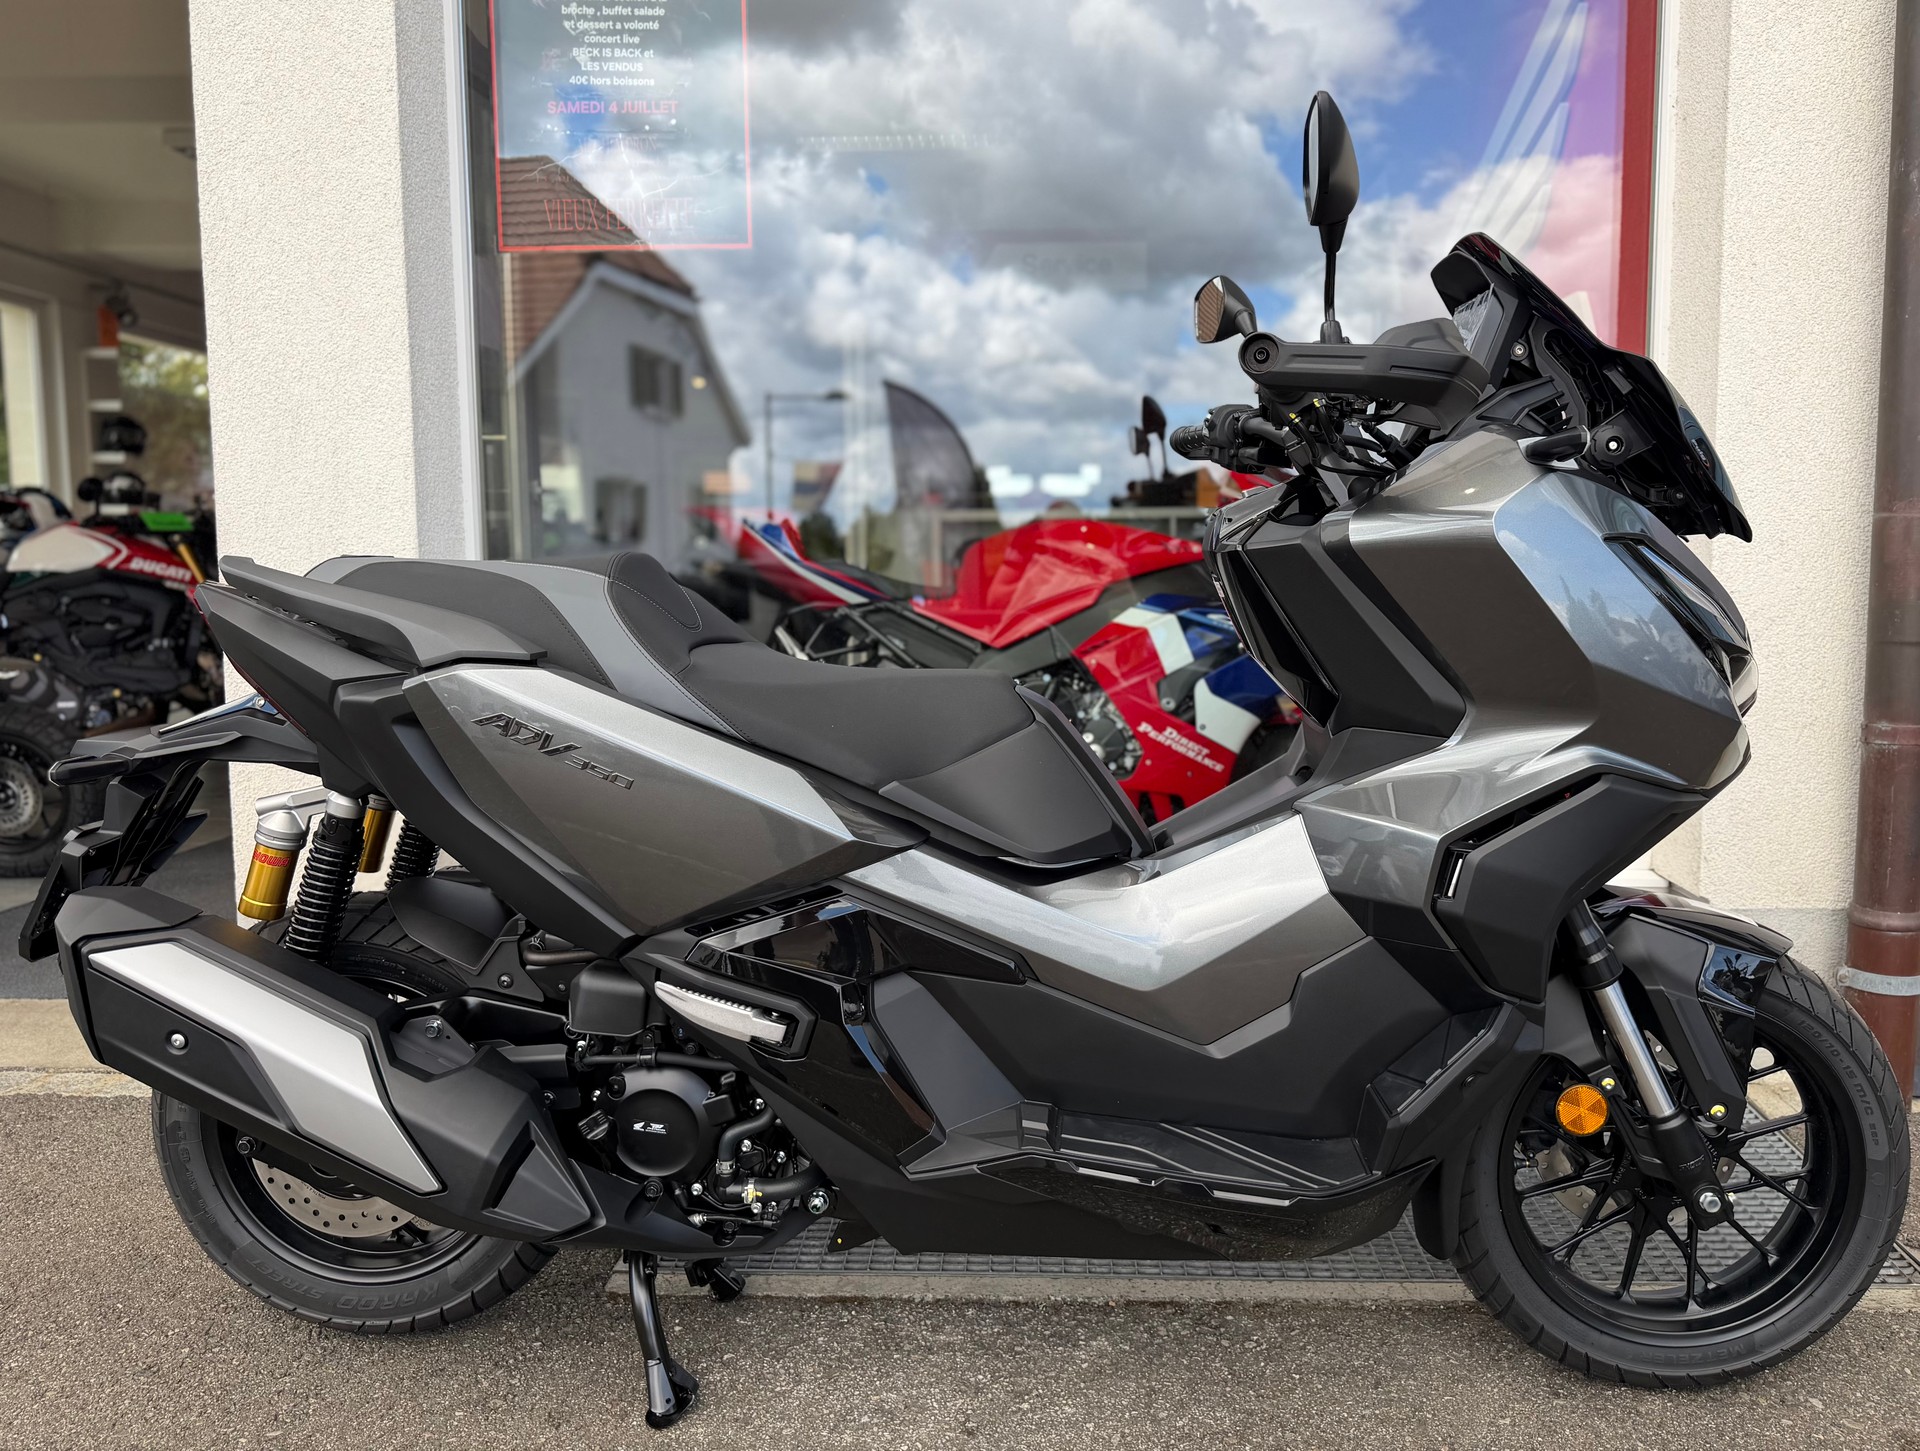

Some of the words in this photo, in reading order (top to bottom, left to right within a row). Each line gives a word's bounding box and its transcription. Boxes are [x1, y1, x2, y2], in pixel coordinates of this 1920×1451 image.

[602, 5, 632, 15] buffet
[633, 5, 666, 16] salade
[564, 20, 576, 29] et
[576, 19, 614, 29] dessert
[623, 19, 660, 30] volonté
[584, 34, 622, 43] concert
[622, 34, 640, 43] live
[572, 47, 601, 57] BECK
[602, 48, 612, 57] IS
[613, 48, 642, 57] BACK
[643, 49, 655, 58] et
[581, 62, 600, 71] LES
[601, 62, 644, 72] VENDUS
[569, 75, 589, 85] 40€
[589, 76, 612, 86] hors
[612, 76, 655, 86] boissons
[547, 101, 605, 114] SAMEDI
[608, 101, 619, 114] 4
[621, 101, 679, 114] JUILLET
[129, 556, 192, 582] DUCATI
[470, 711, 582, 757] ADV
[564, 753, 635, 790] 350
[247, 1259, 328, 1300] STREET
[336, 1279, 441, 1311] KAROO
